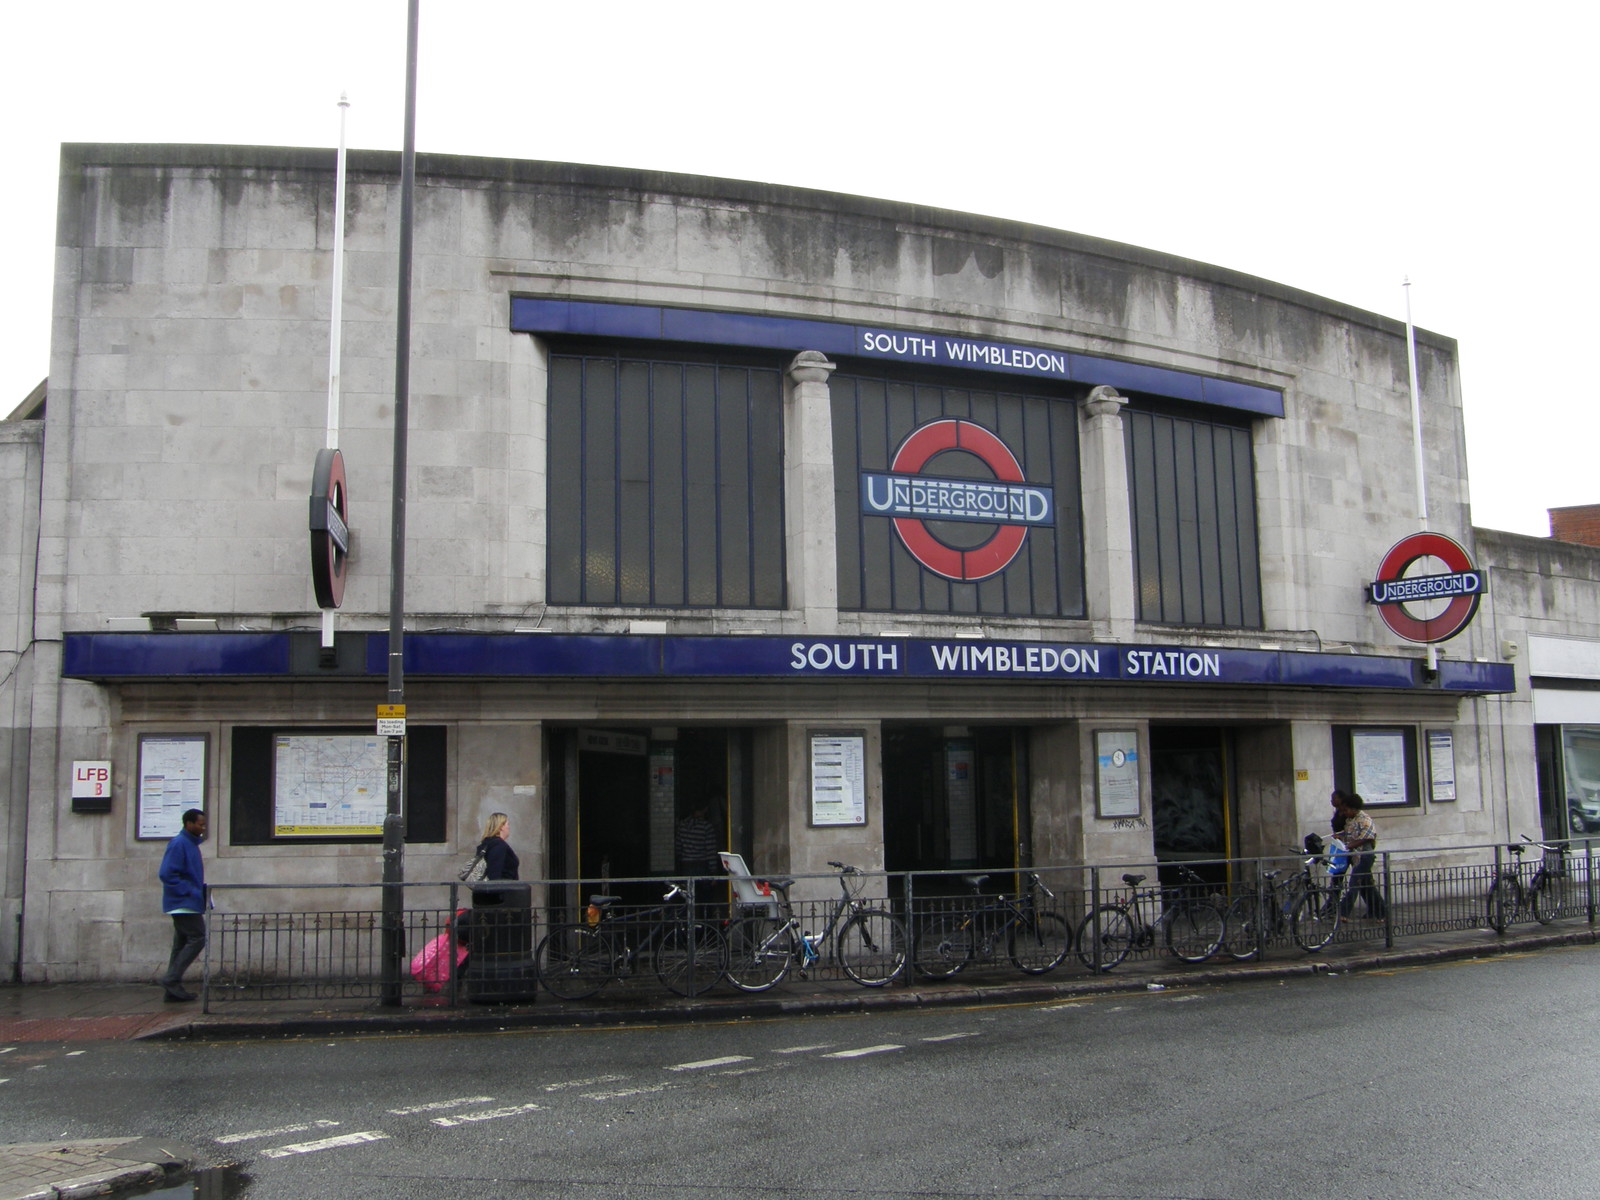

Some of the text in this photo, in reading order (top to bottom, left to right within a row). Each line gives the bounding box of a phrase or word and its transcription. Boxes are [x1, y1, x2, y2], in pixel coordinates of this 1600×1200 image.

[864, 332, 1065, 373] SOUTH WIMBLEDON
[867, 476, 1049, 521] UNDERGROUND
[1372, 573, 1479, 602] UNDERGROUND
[790, 643, 1220, 677] SOUTH WIMBLEDON STATION
[77, 768, 109, 781] LFB
